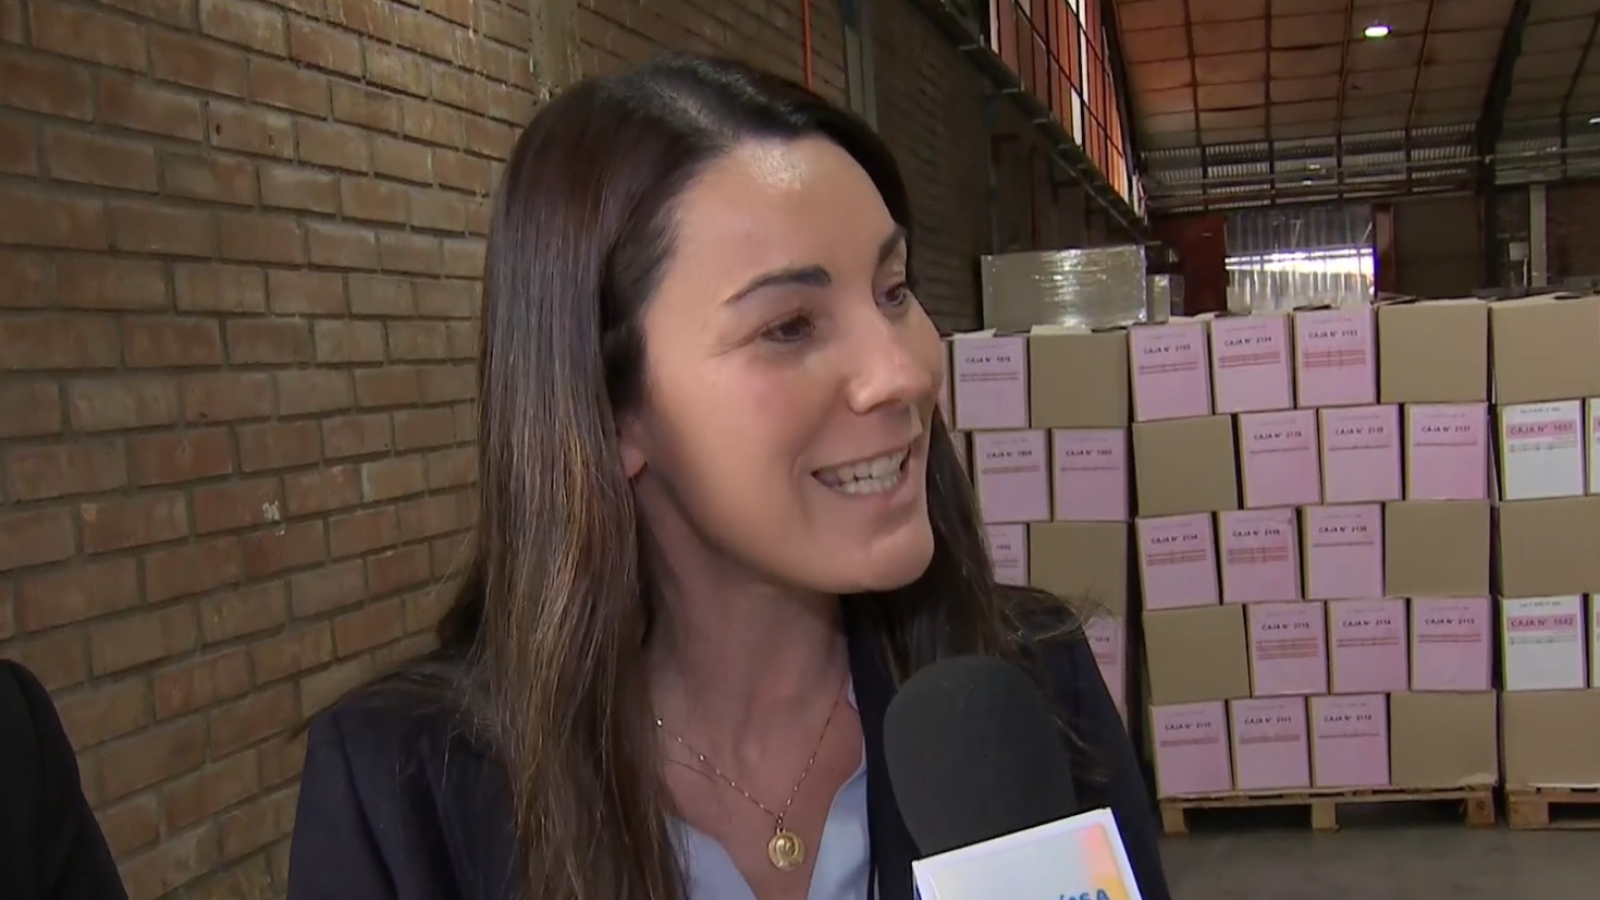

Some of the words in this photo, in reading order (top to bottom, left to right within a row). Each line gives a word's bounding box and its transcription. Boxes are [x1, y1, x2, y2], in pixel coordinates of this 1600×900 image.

[1308, 331, 1329, 340] CAJA
[1224, 338, 1243, 347] CAJA
[1143, 346, 1162, 355] CAJA
[965, 356, 983, 364] CAJA
[1335, 428, 1354, 436] CAJA
[1510, 426, 1535, 436] CAJA
[1253, 433, 1272, 441] CAJA
[986, 451, 1005, 459] CAJA
[1232, 530, 1251, 538] CAJA
[1318, 526, 1338, 534] CAJA
[1151, 536, 1170, 544] CAJA
[1510, 619, 1536, 628] CAJA
[1261, 624, 1282, 632] CAJA
[1164, 722, 1185, 731] CAJA
